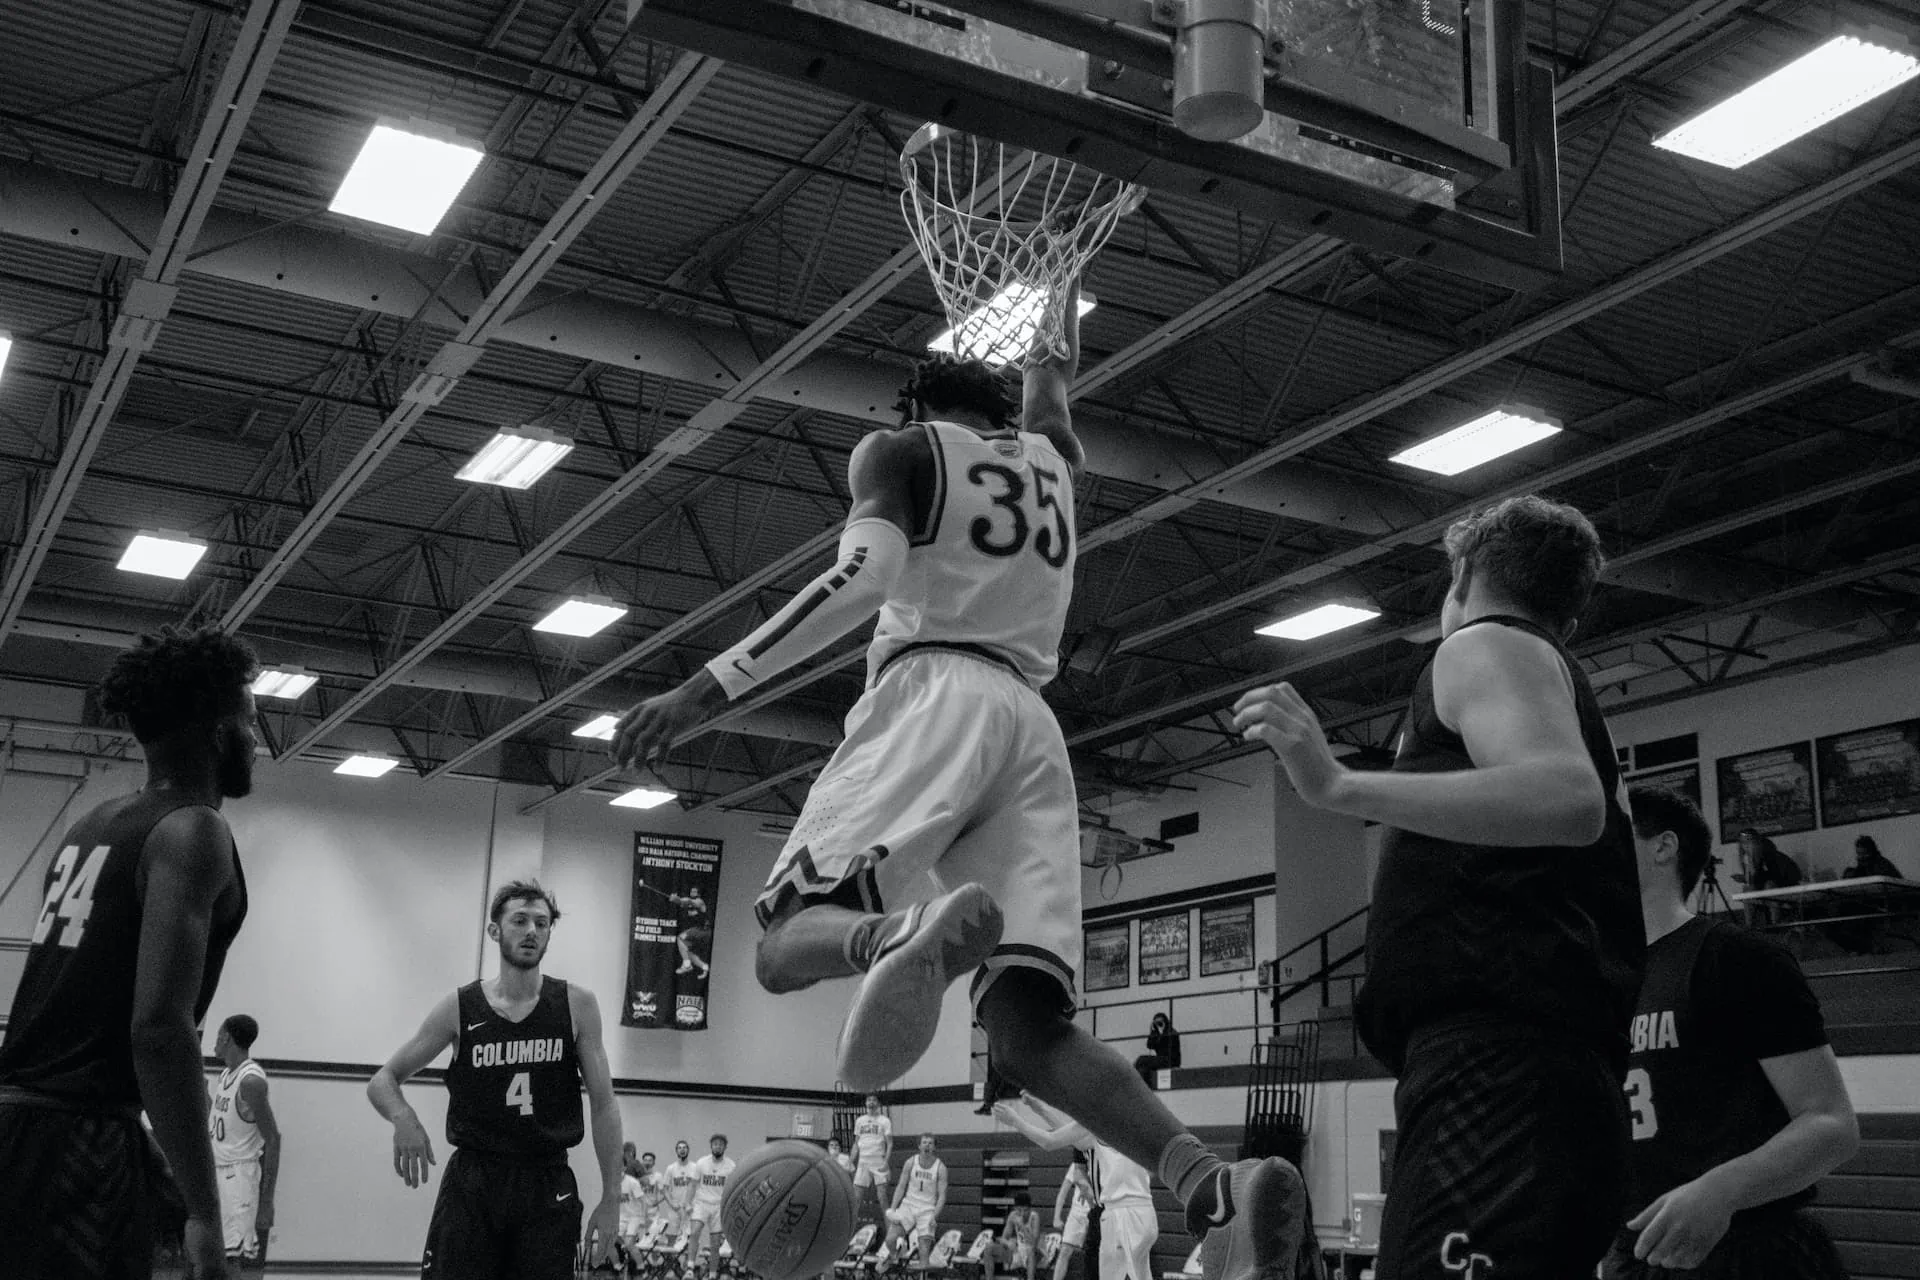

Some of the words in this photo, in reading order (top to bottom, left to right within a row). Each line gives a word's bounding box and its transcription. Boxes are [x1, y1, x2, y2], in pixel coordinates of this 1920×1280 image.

[967, 460, 1070, 568] 35
[642, 856, 675, 869] ANTHONY
[675, 860, 713, 873] STOCKTON
[31, 845, 111, 947] 24
[472, 1038, 563, 1068] COLUMBIA
[1630, 1010, 1680, 1053] BIA
[505, 1072, 534, 1116] 4
